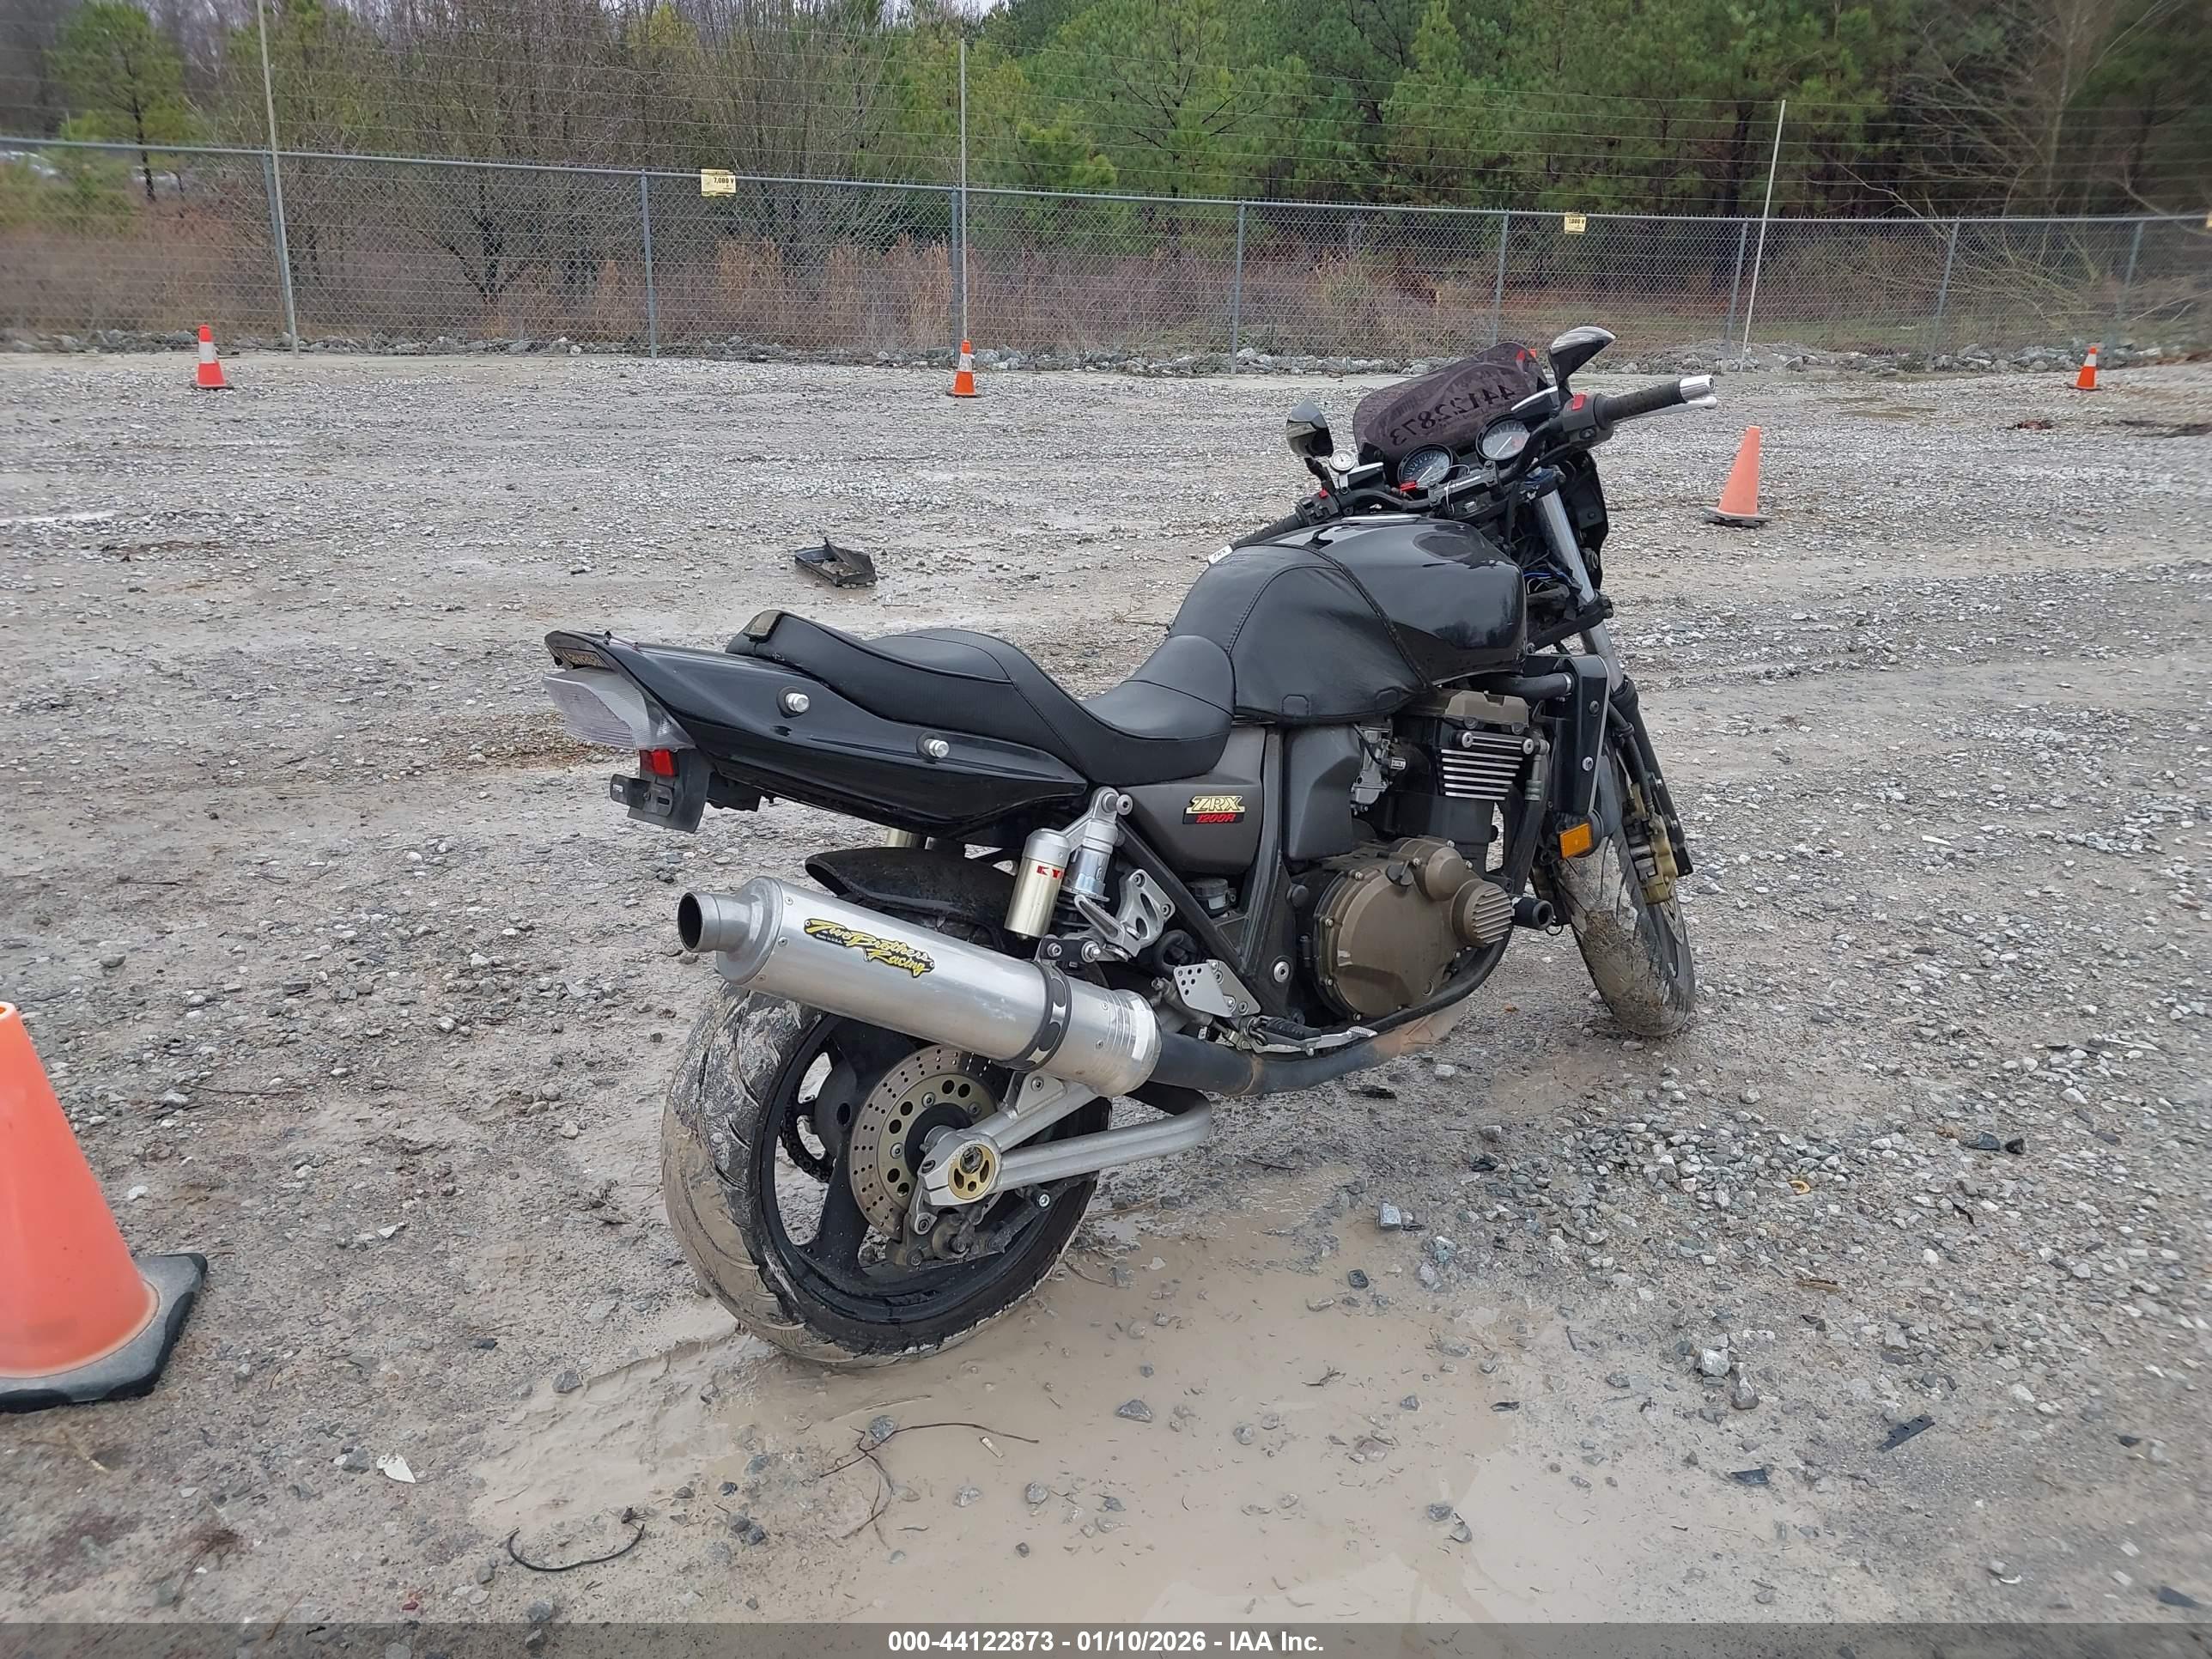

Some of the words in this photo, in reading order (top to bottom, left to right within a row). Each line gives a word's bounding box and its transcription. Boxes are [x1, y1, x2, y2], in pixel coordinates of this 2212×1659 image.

[1190, 796, 1243, 811] ZRX
[1195, 813, 1237, 823] 1200R
[1036, 865, 1063, 879] KY
[843, 931, 933, 962] Brothers
[865, 947, 931, 976] Racing
